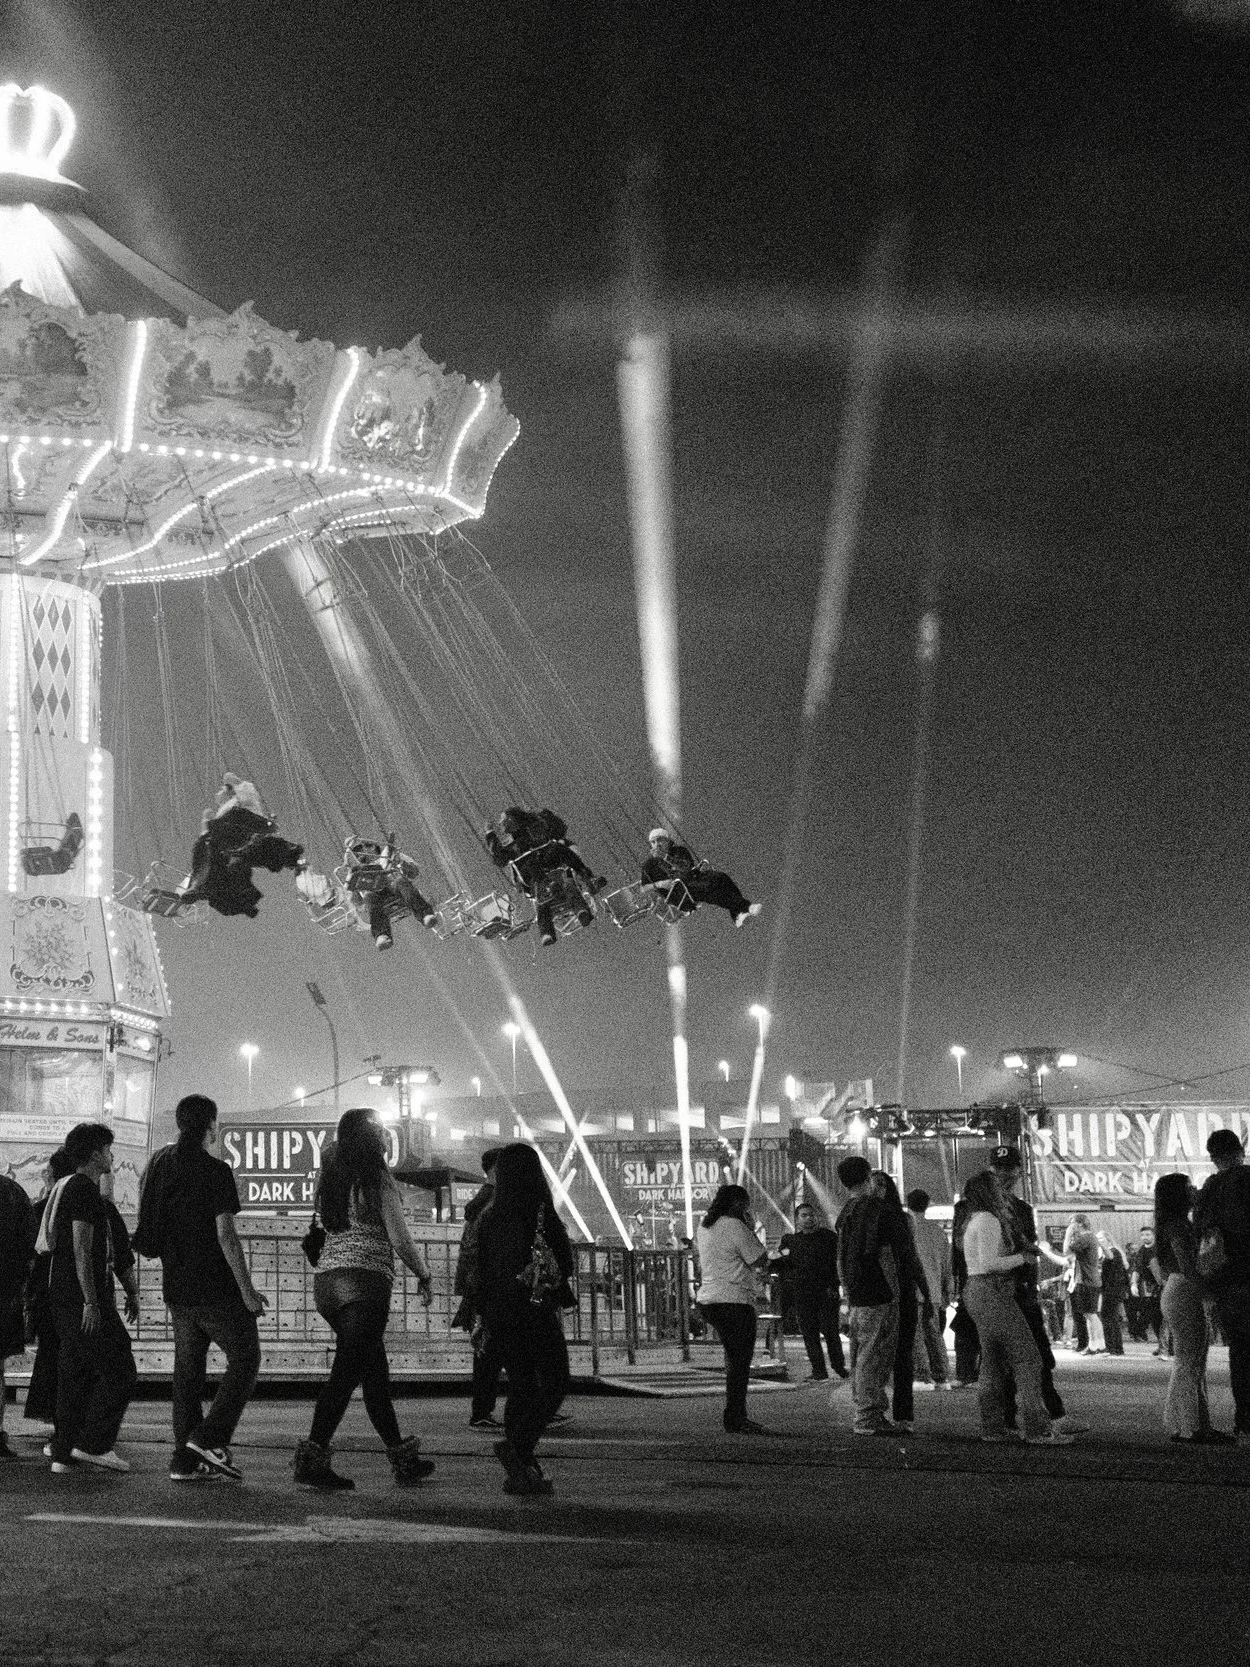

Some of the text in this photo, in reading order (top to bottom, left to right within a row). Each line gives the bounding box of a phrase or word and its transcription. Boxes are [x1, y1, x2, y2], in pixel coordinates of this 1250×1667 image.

[0, 1023, 41, 1041] Helm
[46, 1026, 59, 1042] &
[64, 1027, 100, 1044] Sons
[223, 1129, 400, 1170] SHIPYD
[1138, 1158, 1151, 1169] AT
[307, 1170, 317, 1179] AT
[1064, 1170, 1126, 1194] DARK
[248, 1182, 296, 1202] DARK
[456, 1188, 473, 1201] RIDE
[638, 1189, 665, 1201] DARK
